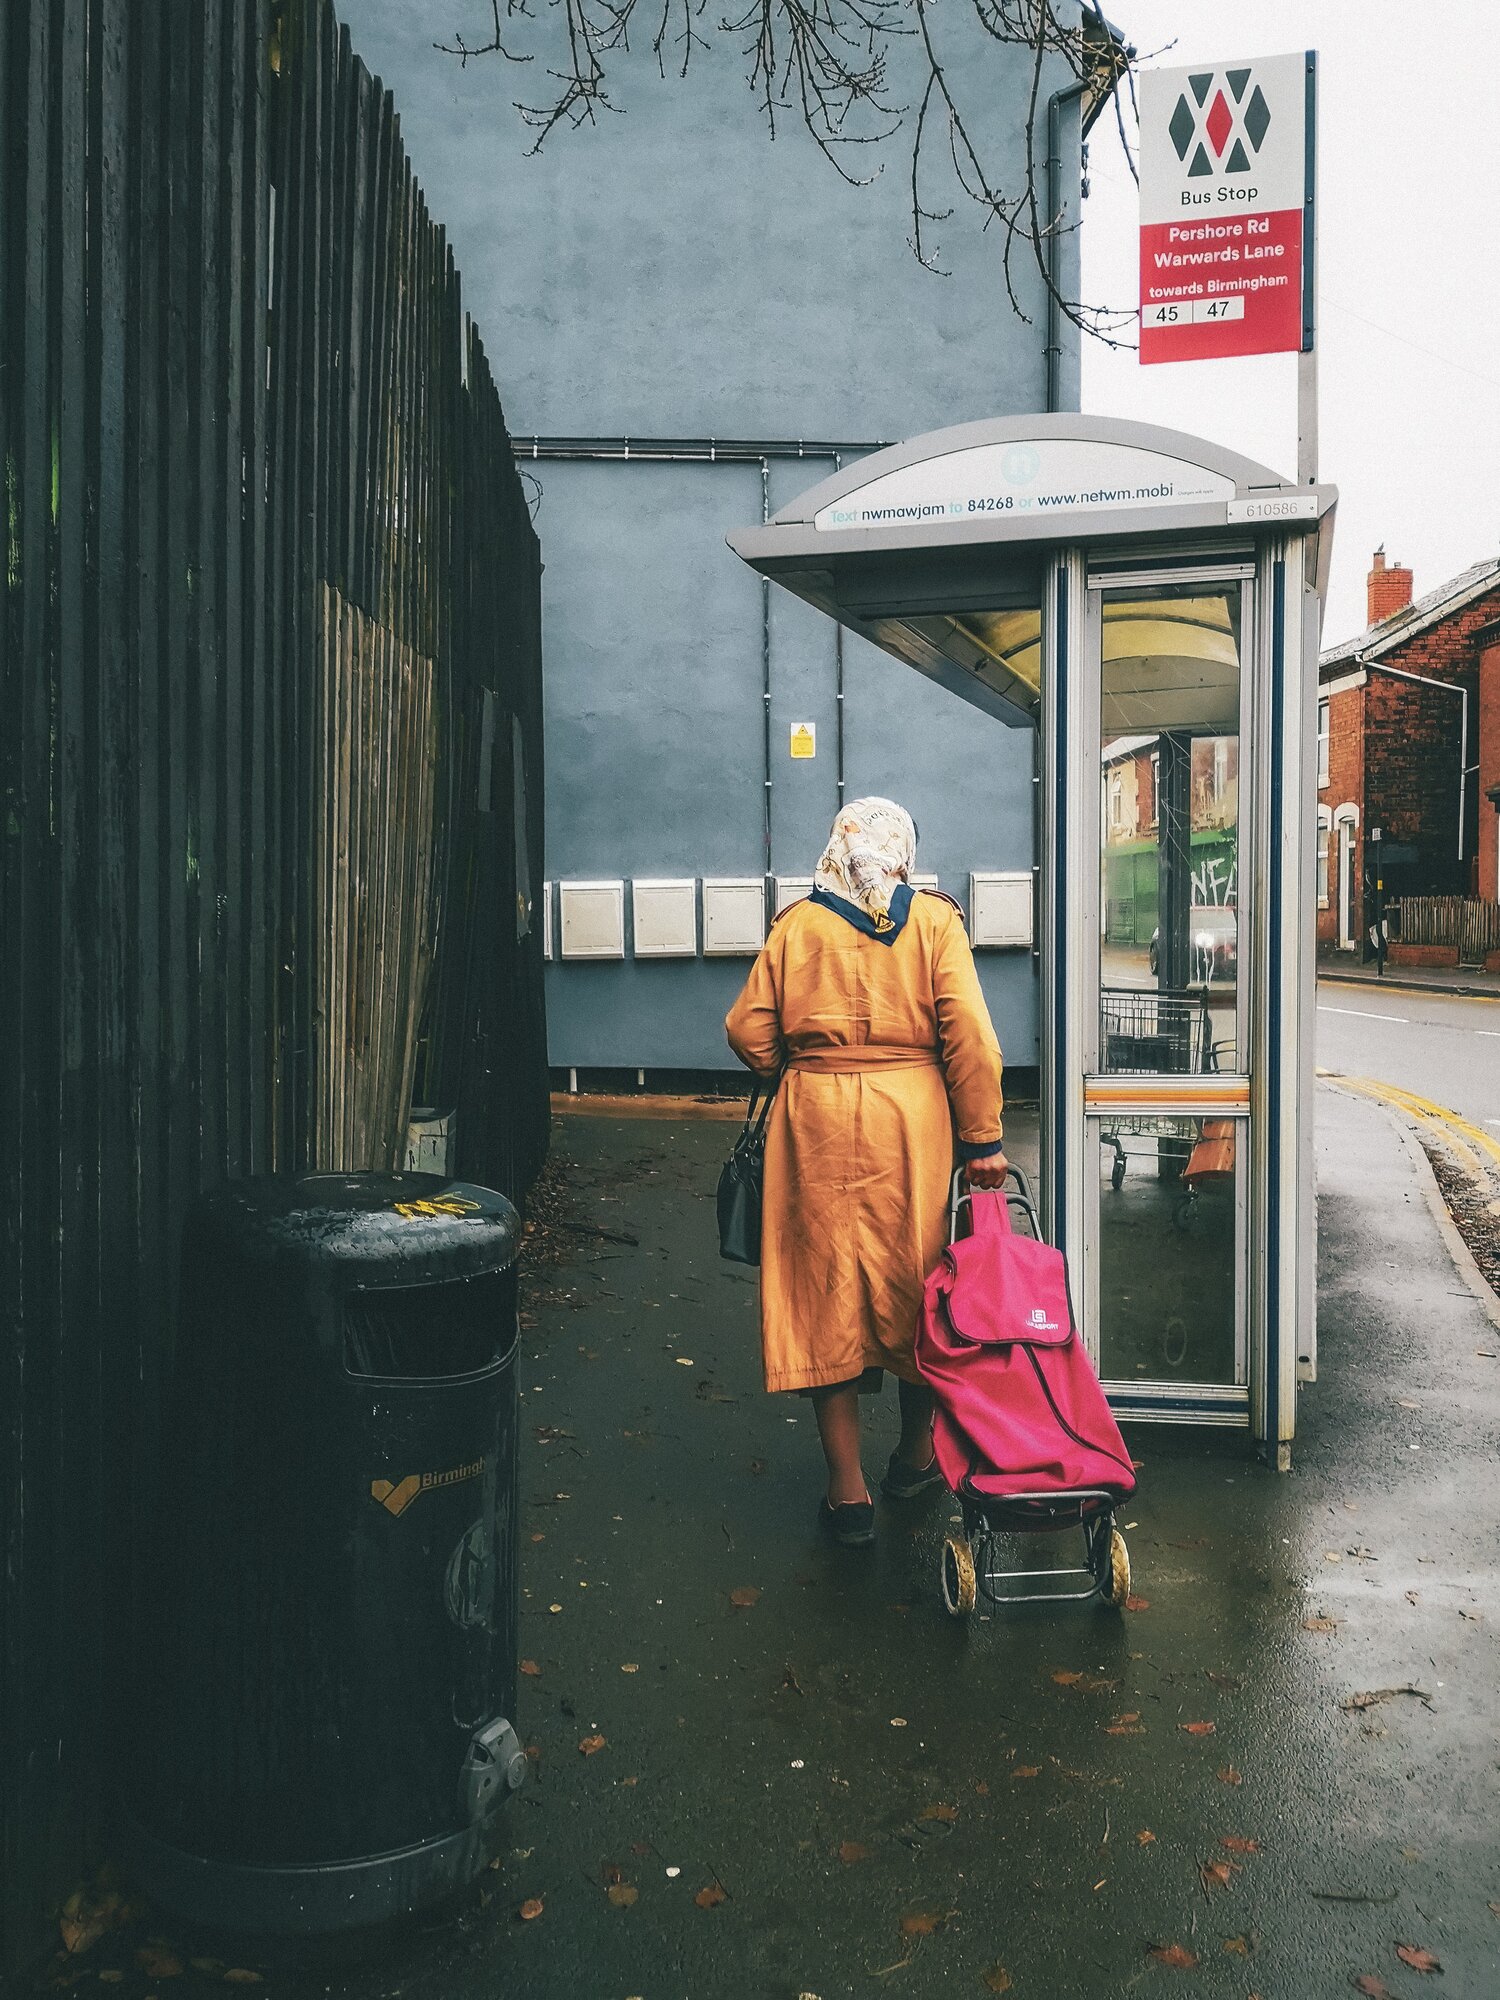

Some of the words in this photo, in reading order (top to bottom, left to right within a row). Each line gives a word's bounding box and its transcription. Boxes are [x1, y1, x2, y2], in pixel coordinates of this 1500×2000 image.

[1181, 191, 1211, 205] Bus
[1217, 187, 1258, 202] Stop
[1169, 224, 1243, 242] Pershore
[1247, 217, 1270, 235] Rd
[1154, 246, 1240, 268] Warwards
[1244, 244, 1285, 260] Lane
[1149, 281, 1204, 298] towards
[1207, 275, 1288, 292] Birmingham
[1156, 306, 1178, 322] 45
[1207, 301, 1229, 317] 47
[831, 509, 858, 523] Text
[862, 503, 945, 521] nwmawjam
[950, 501, 963, 513] to
[968, 496, 1014, 512] 84268
[1018, 497, 1034, 508] or
[1037, 482, 1174, 506] www.netwm.mobi
[1246, 502, 1298, 517] 610586
